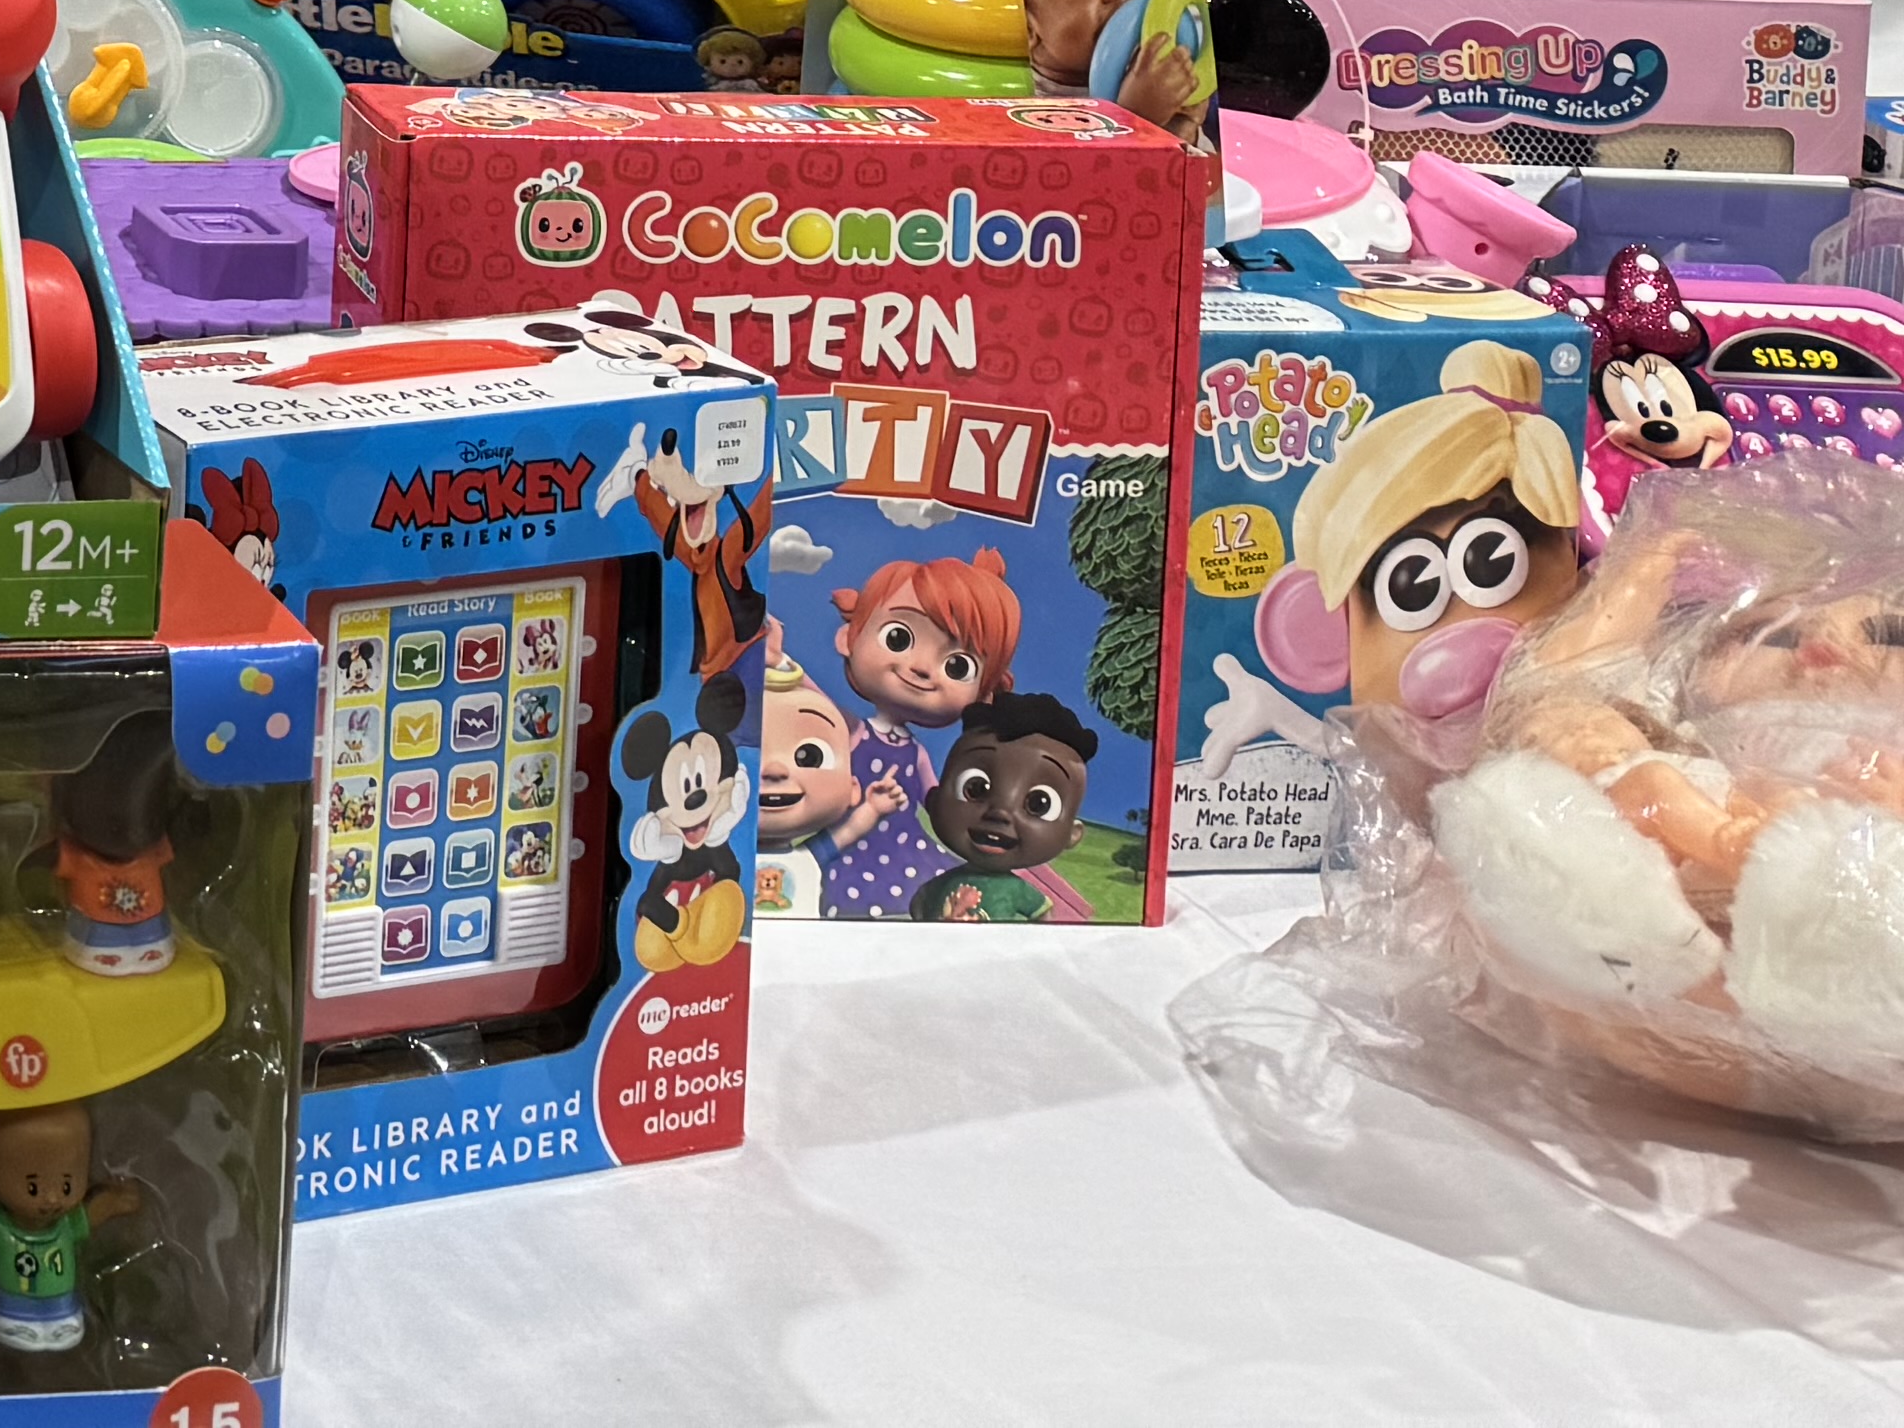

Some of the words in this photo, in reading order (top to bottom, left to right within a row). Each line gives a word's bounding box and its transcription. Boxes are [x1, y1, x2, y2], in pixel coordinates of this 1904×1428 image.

[1338, 40, 1531, 91] Dressing
[1535, 32, 1605, 81] Up
[1744, 61, 1823, 89] Buddy
[1823, 67, 1837, 86] &
[1438, 86, 1491, 106] Bath
[1497, 89, 1549, 111] Time
[1553, 87, 1651, 120] Stickers!
[1744, 86, 1838, 116] Barney
[1752, 346, 1838, 371] $15.99
[1206, 352, 1352, 421] Potato
[195, 399, 416, 433] ELECTRONIC
[426, 387, 554, 414] READER
[1734, 395, 1747, 417] 1
[1779, 394, 1793, 416] 2
[1821, 399, 1837, 420] 3
[372, 452, 596, 532] MICKEY
[1056, 474, 1144, 499] Game
[1212, 513, 1255, 553] 12
[1173, 781, 1210, 804] Mrs.
[1217, 781, 1278, 804] Potato
[1284, 781, 1329, 803] Head
[1196, 806, 1239, 828] Mme.
[1247, 804, 1302, 828] Patate
[6, 1043, 41, 1080] fp
[646, 1039, 721, 1070] Reads
[644, 1105, 717, 1135] aloud!
